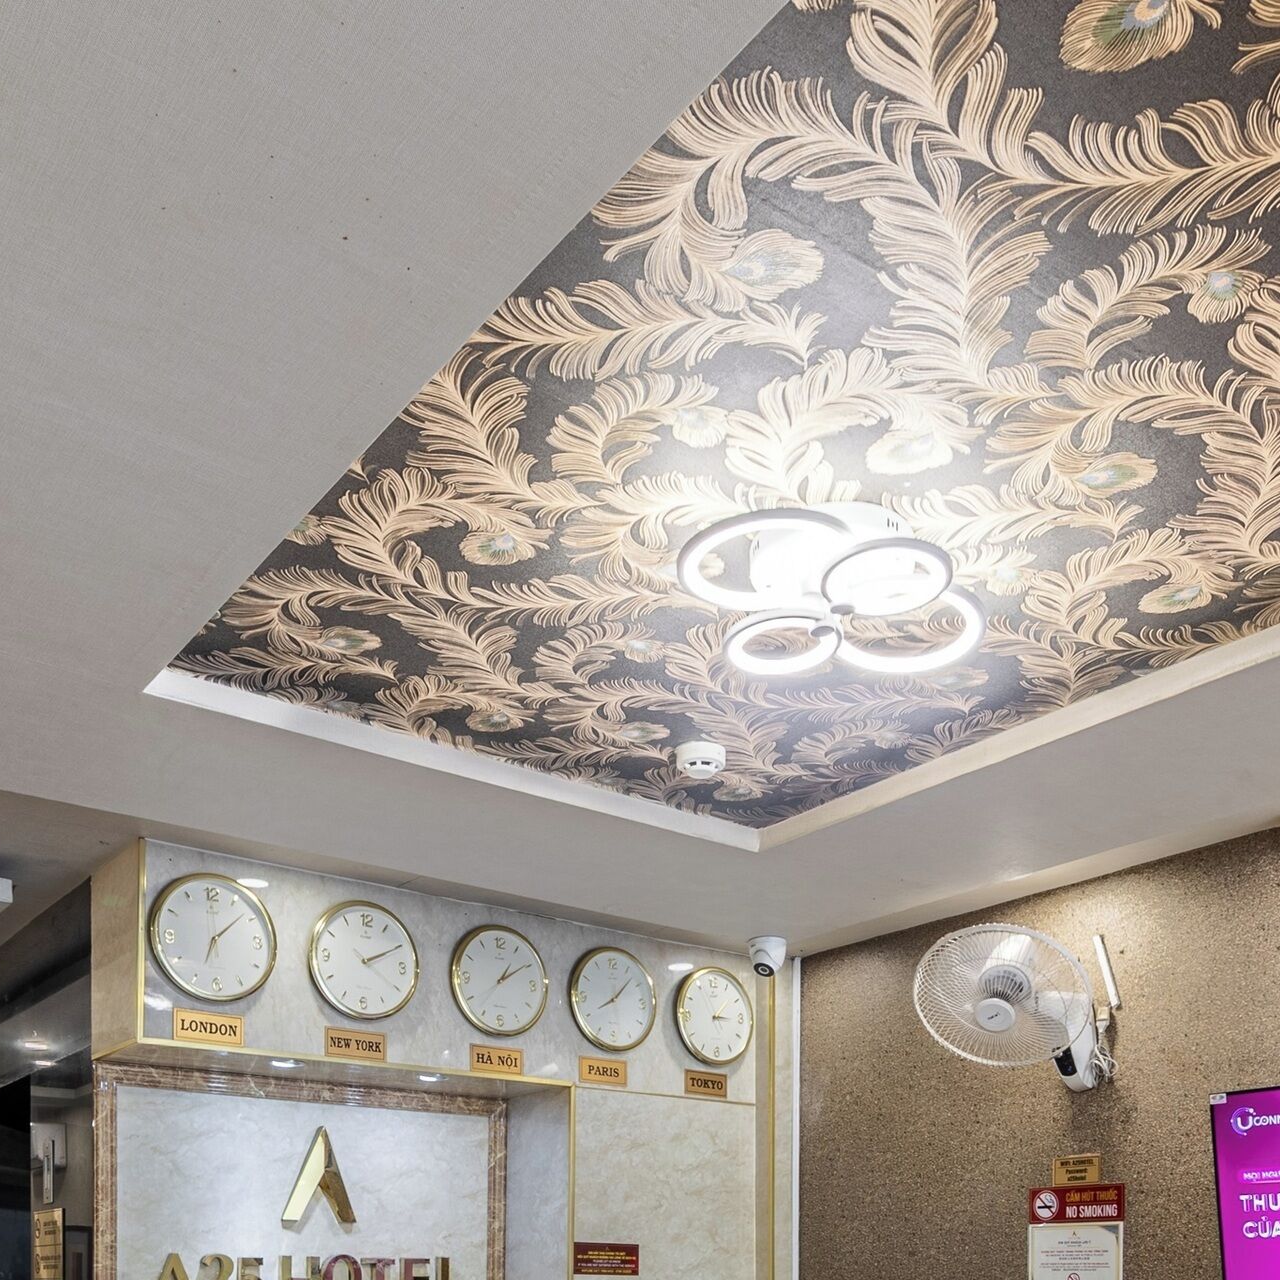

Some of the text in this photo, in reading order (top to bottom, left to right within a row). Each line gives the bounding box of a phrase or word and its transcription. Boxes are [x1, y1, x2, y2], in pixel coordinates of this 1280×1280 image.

[204, 887, 220, 902] 12
[360, 913, 373, 928] 12
[164, 929, 175, 944] 9
[252, 936, 263, 950] 3
[494, 937, 506, 950] 12
[322, 948, 330, 962] 9
[399, 962, 407, 975] 3
[608, 958, 618, 970] 12
[211, 977, 222, 992] 6
[462, 971, 470, 984] 9
[529, 980, 537, 992] 3
[358, 997, 368, 1010] 6
[496, 1014, 504, 1027] 6
[737, 1013, 744, 1025] 3
[180, 1018, 238, 1037] LONDON
[330, 1036, 382, 1054] NEW YORK
[713, 1046, 720, 1058] 6
[476, 1051, 518, 1069] HÀ NỘI
[588, 1065, 619, 1079] PARIS
[689, 1078, 724, 1091] TOKYO
[1066, 1187, 1118, 1203] CẤM HÚT THUỐC
[1066, 1204, 1118, 1218] NO SMOKING
